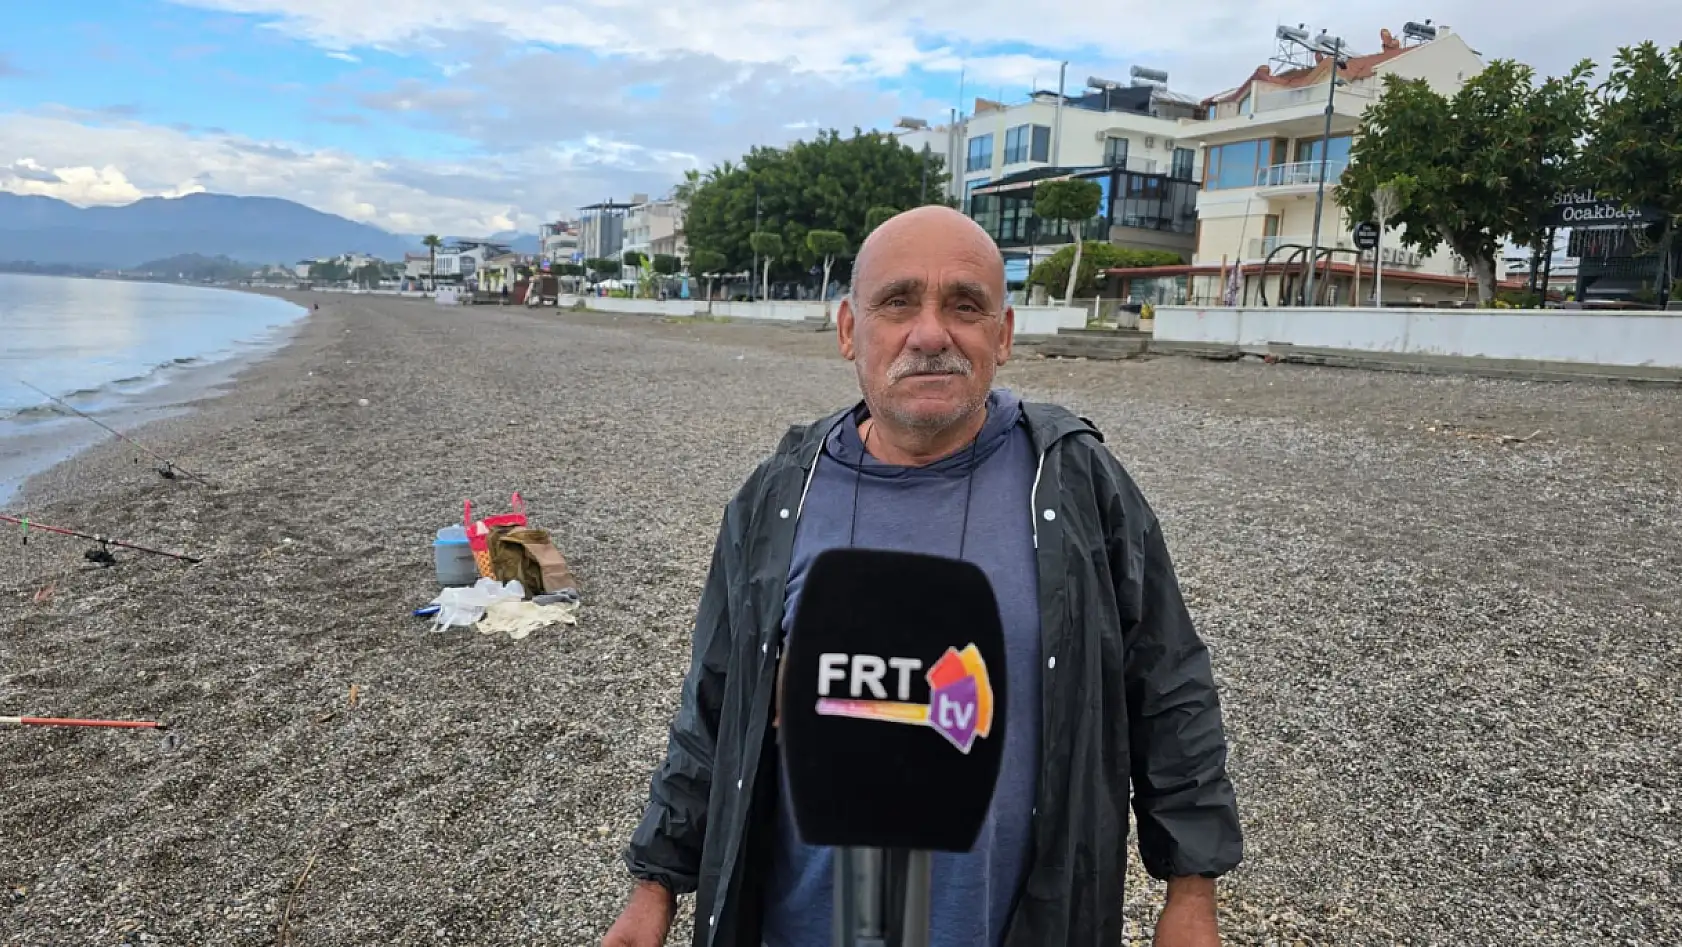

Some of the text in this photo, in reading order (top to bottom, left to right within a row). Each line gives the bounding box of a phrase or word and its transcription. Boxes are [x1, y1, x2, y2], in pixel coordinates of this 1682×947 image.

[1562, 204, 1642, 221] Ocakbaşı
[817, 652, 975, 730] FRT tv
